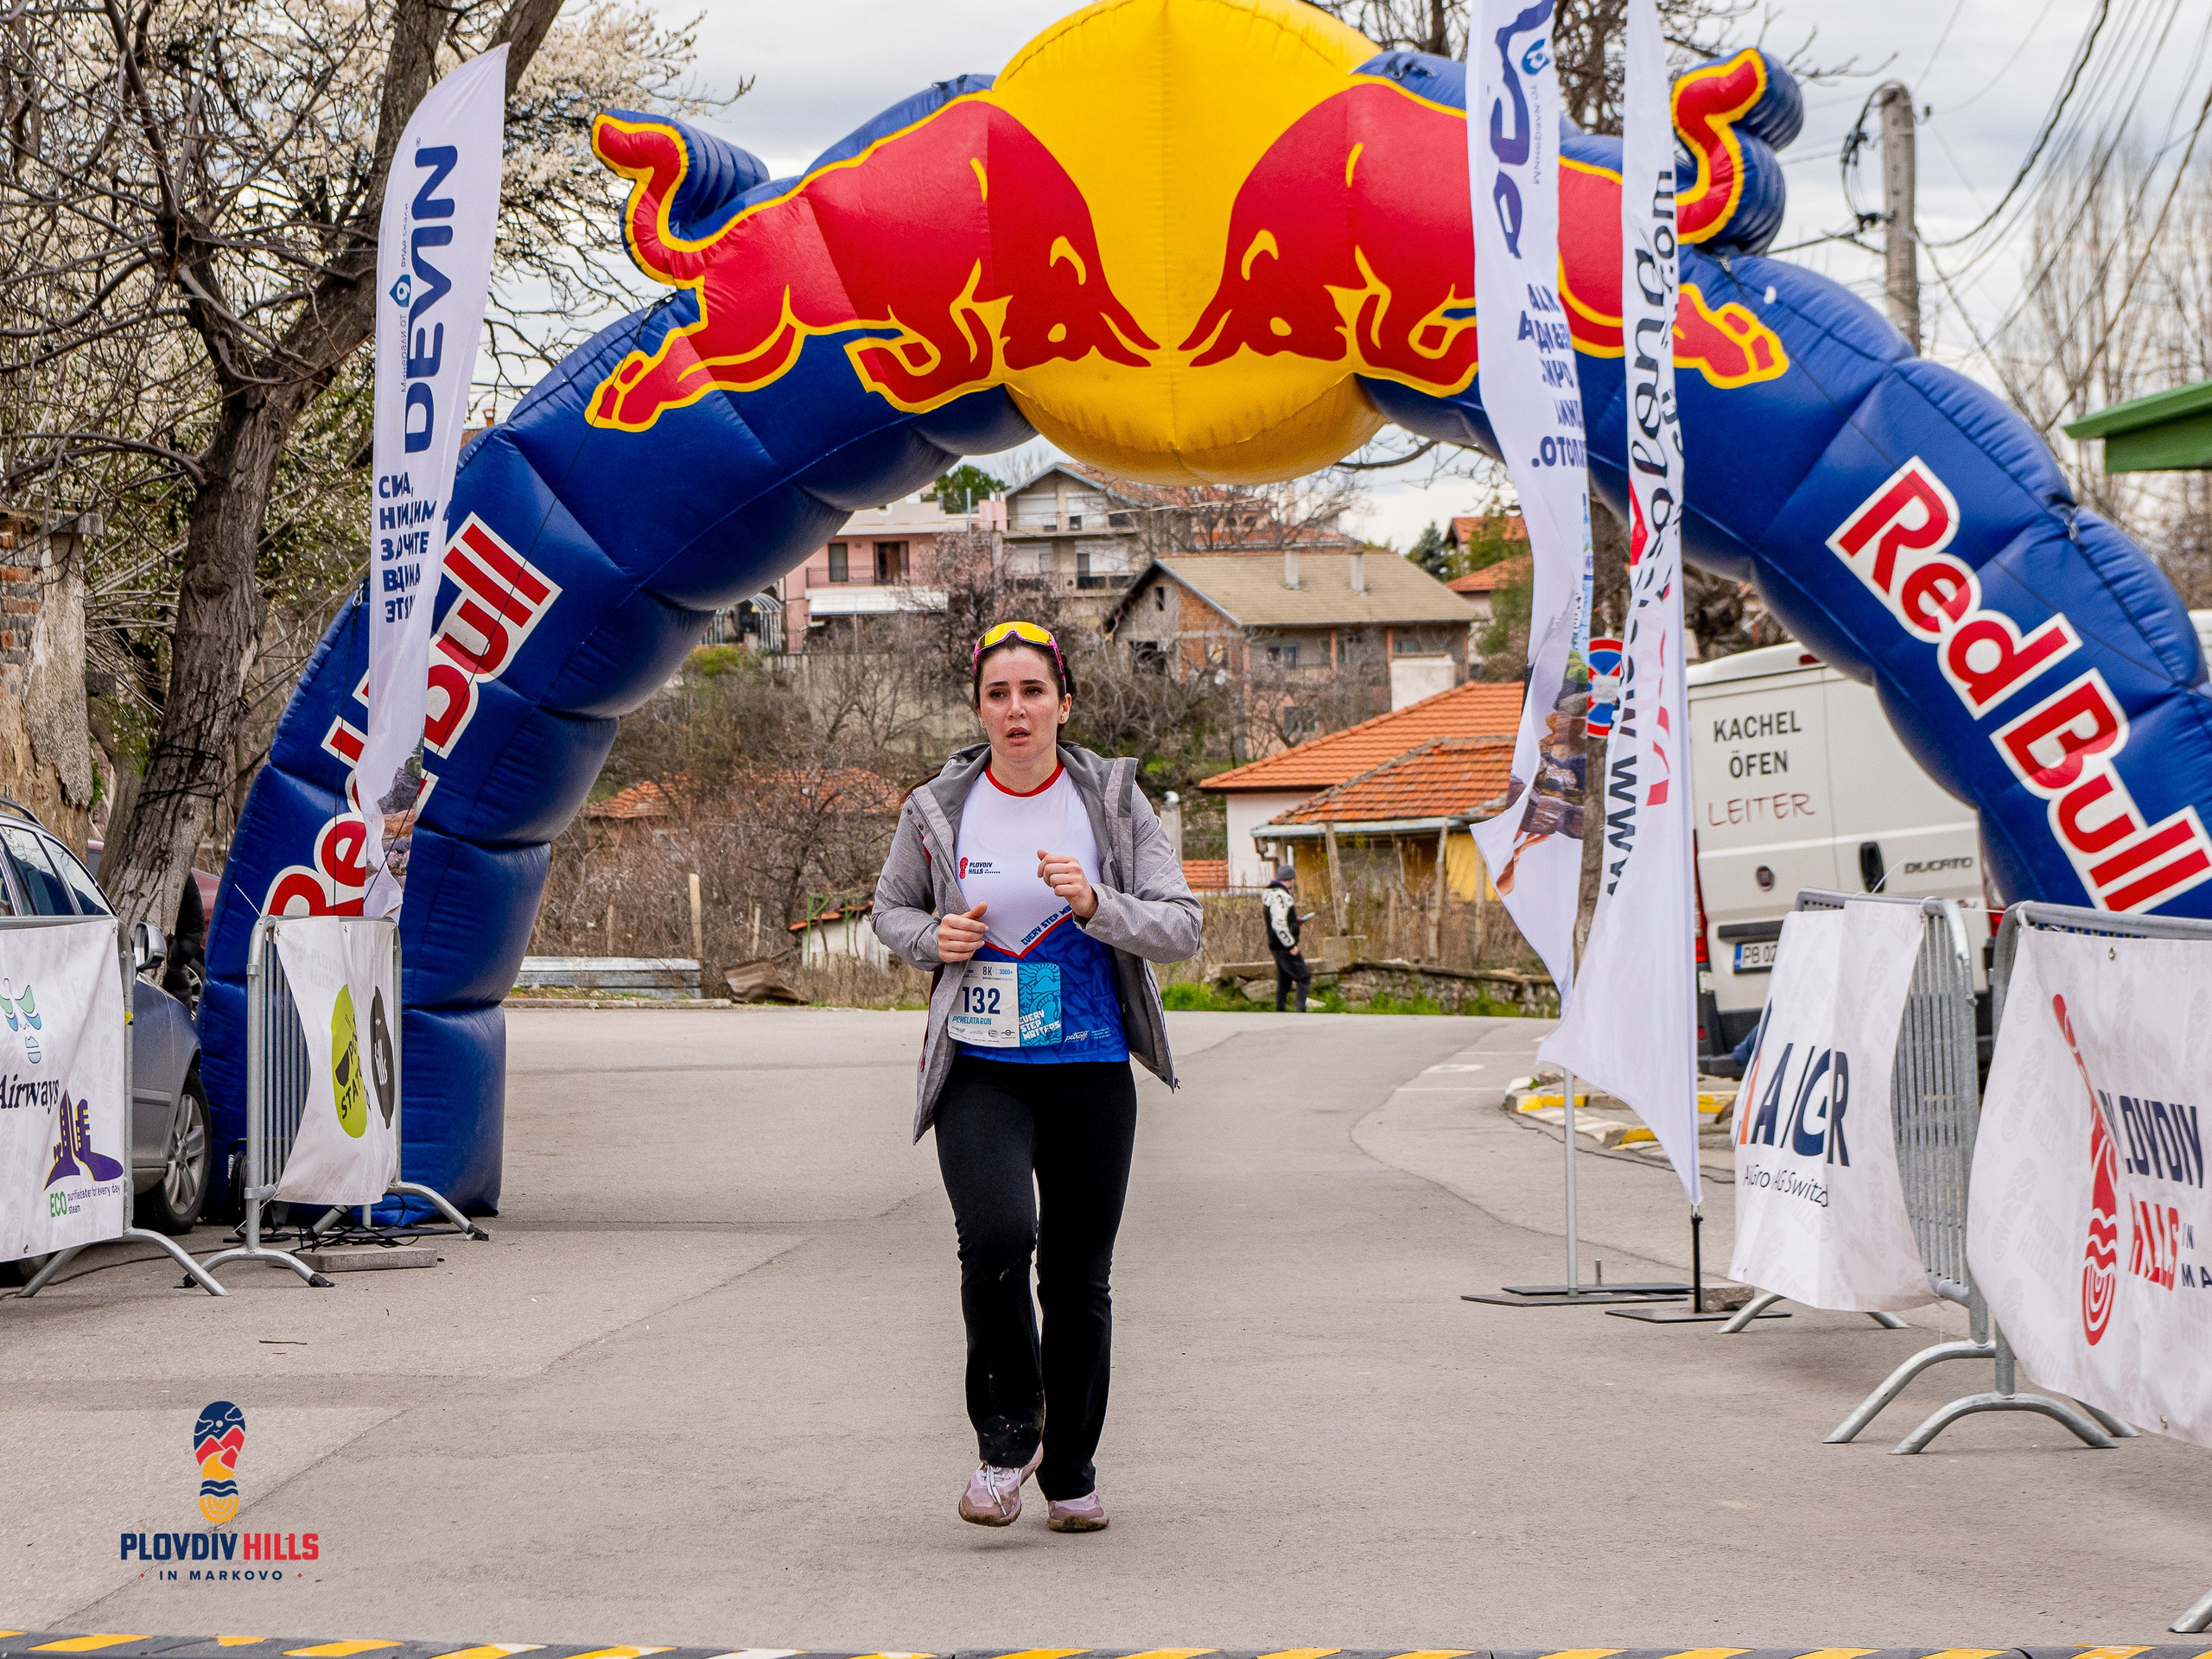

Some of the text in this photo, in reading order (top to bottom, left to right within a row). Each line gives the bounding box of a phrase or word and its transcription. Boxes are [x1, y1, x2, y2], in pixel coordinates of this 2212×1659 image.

[404, 145, 459, 454] DEVIN
[1835, 467, 2212, 912] Red Bull
[1713, 710, 1802, 743] KACHEL
[1730, 749, 1789, 779] ÖFEN
[1707, 792, 1817, 827] LEITER
[1904, 856, 1973, 874] DUCATO
[1020, 925, 1042, 945] EVERY
[1040, 912, 1059, 929] STEP
[982, 966, 993, 976] 8K
[962, 986, 1001, 1014] 132
[952, 1015, 992, 1026] PCHELATA RUN
[1020, 1009, 1045, 1025] EVERY
[1020, 1019, 1041, 1033] STEP
[1022, 1020, 1061, 1040] MATTERS
[49, 1191, 67, 1218] ECO
[98, 1185, 111, 1197] every
[111, 1184, 121, 1195] day
